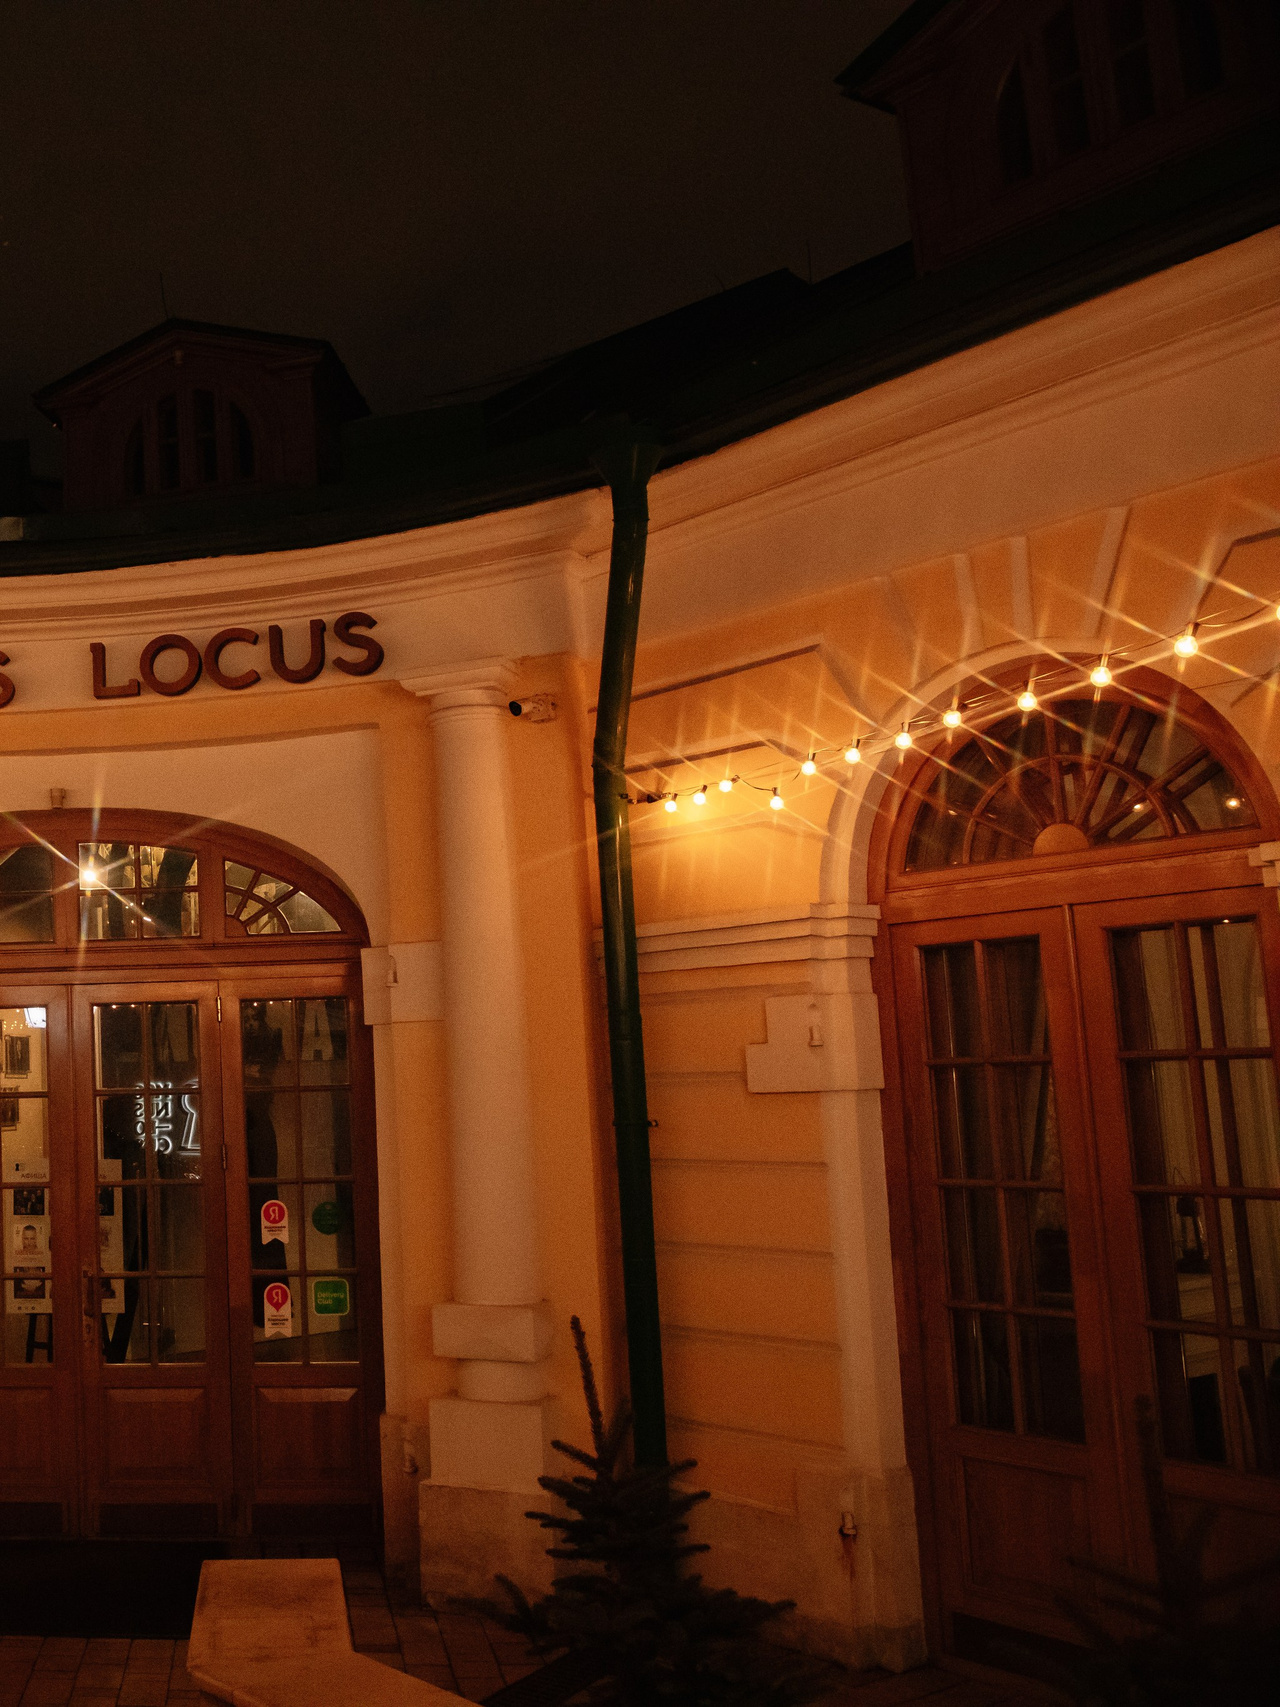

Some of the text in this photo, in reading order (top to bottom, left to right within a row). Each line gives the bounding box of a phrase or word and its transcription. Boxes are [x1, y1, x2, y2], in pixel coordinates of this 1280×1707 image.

[89, 611, 385, 699] LOCUS
[269, 1206, 279, 1221] Я
[272, 1288, 282, 1303] Я
